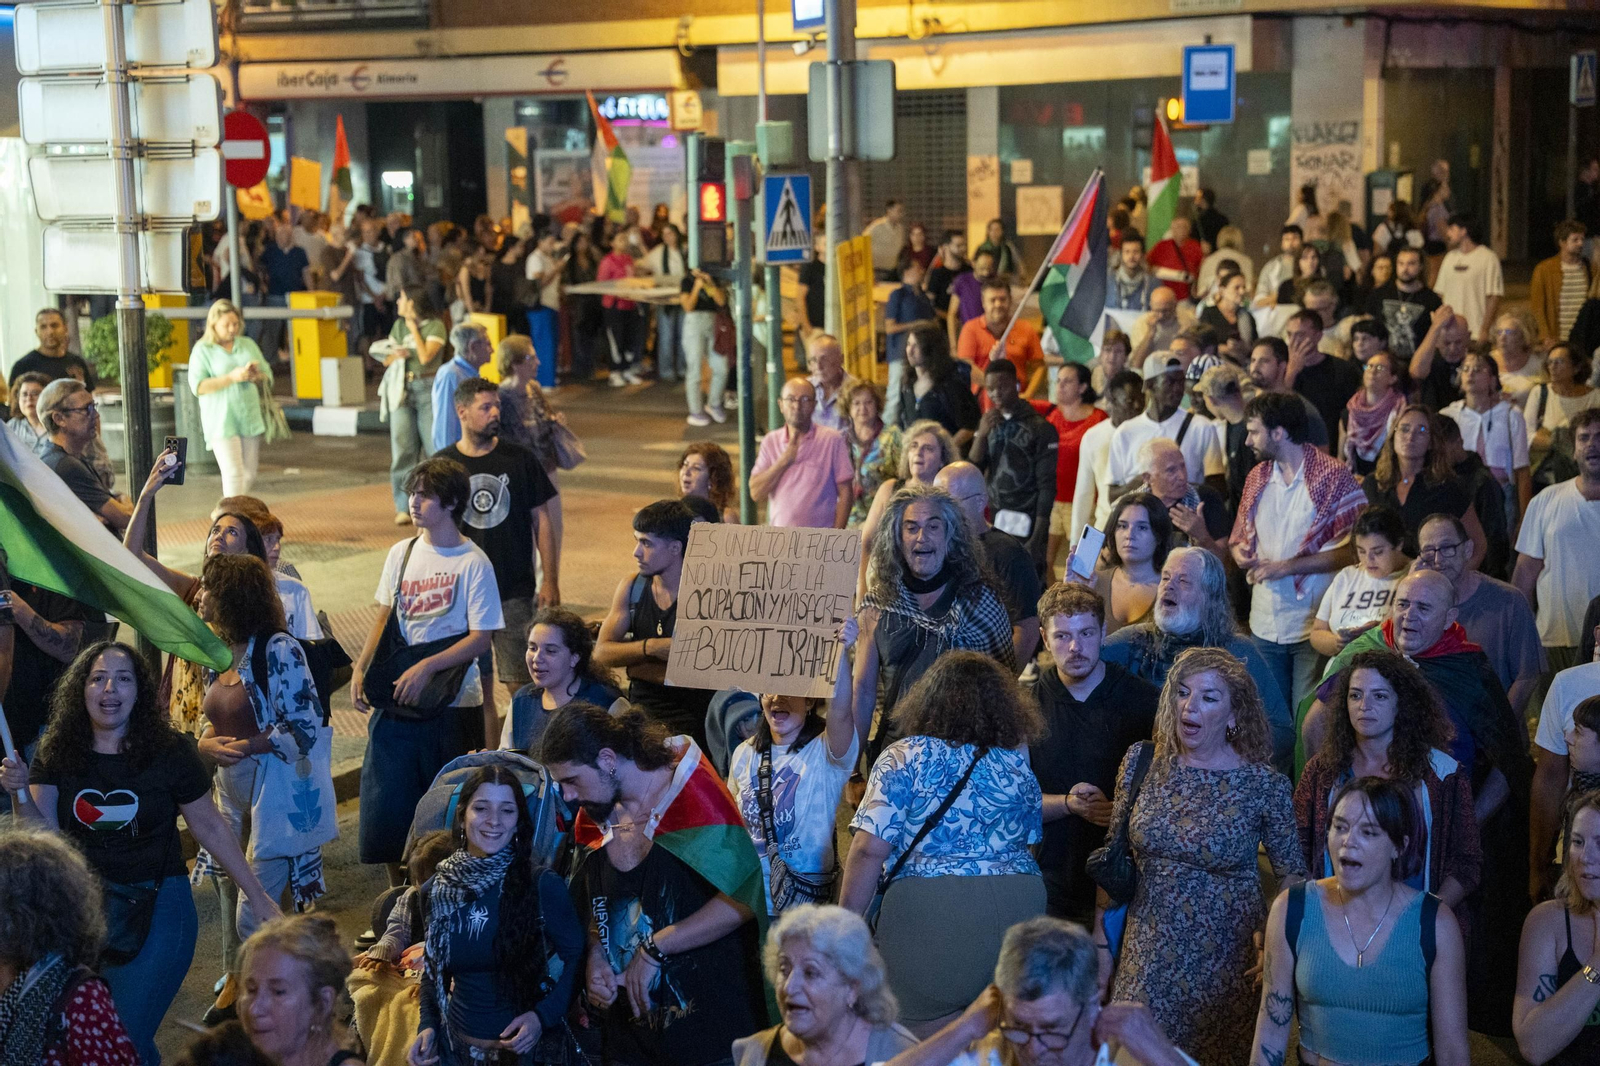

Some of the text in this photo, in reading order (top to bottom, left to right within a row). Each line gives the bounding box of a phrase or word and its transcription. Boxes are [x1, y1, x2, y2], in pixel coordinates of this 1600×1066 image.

[688, 529, 858, 565] ES UN ALTO AL FUEGO,
[685, 560, 825, 591] NO UN FIN DE LA
[769, 593, 779, 620] Y
[776, 593, 849, 626] MASACRE
[674, 625, 774, 675] #BOICOT
[784, 843, 802, 852] ERICA
[784, 851, 793, 859] 78
